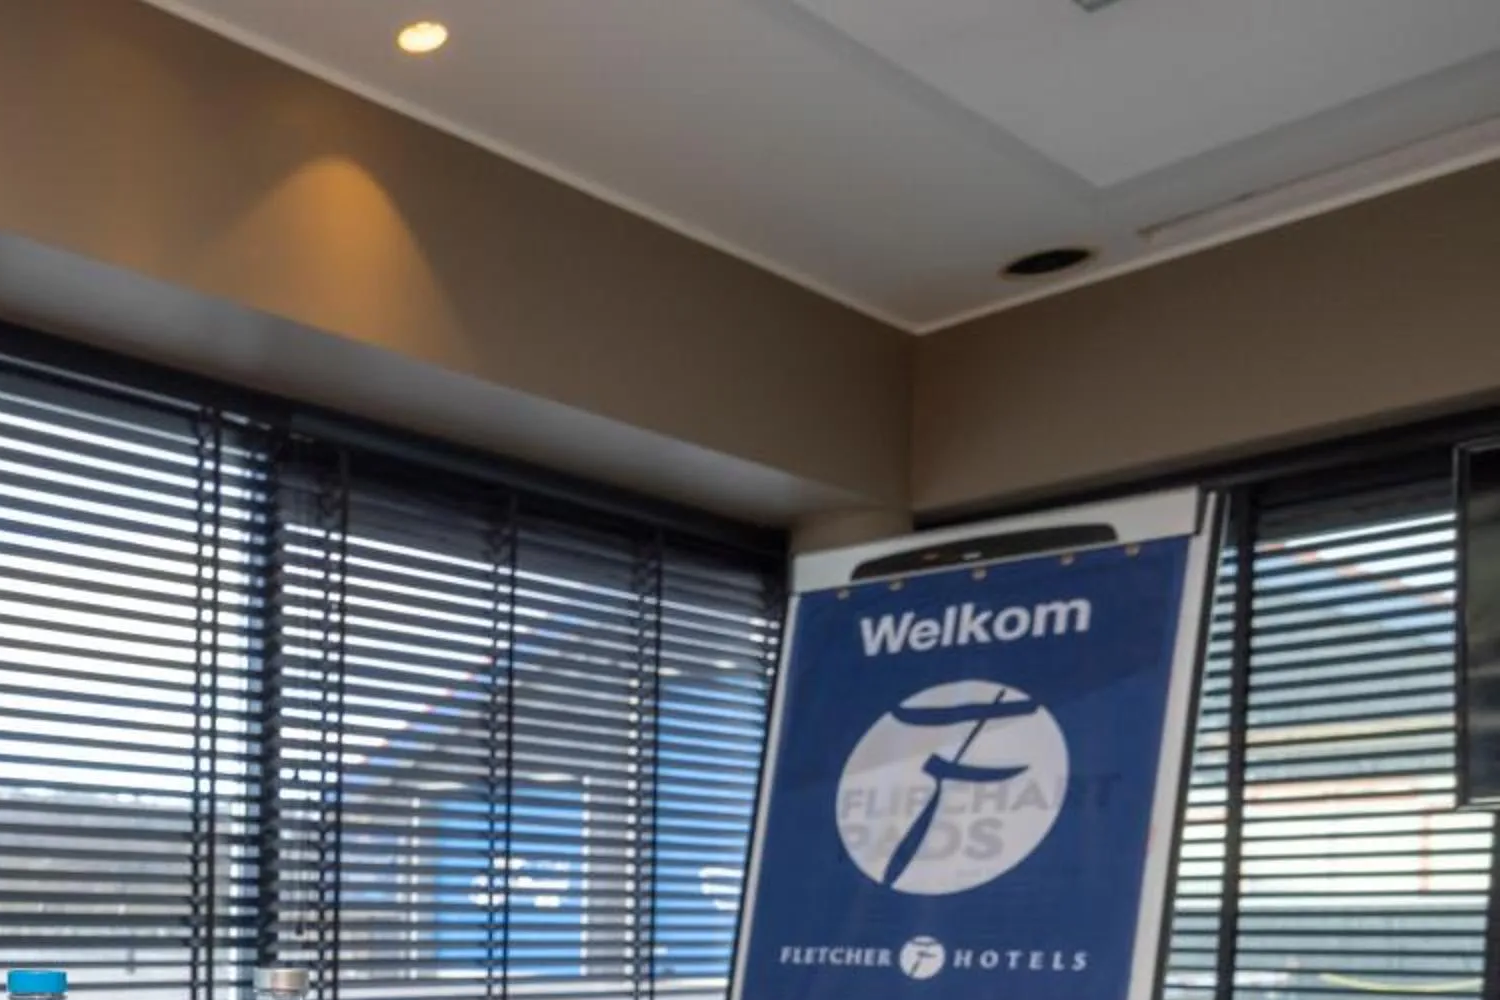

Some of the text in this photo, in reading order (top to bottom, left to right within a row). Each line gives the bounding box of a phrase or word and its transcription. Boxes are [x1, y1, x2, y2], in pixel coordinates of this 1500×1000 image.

[859, 598, 1091, 656] Welkom
[779, 945, 1090, 972] FLETCHER HOTELS
